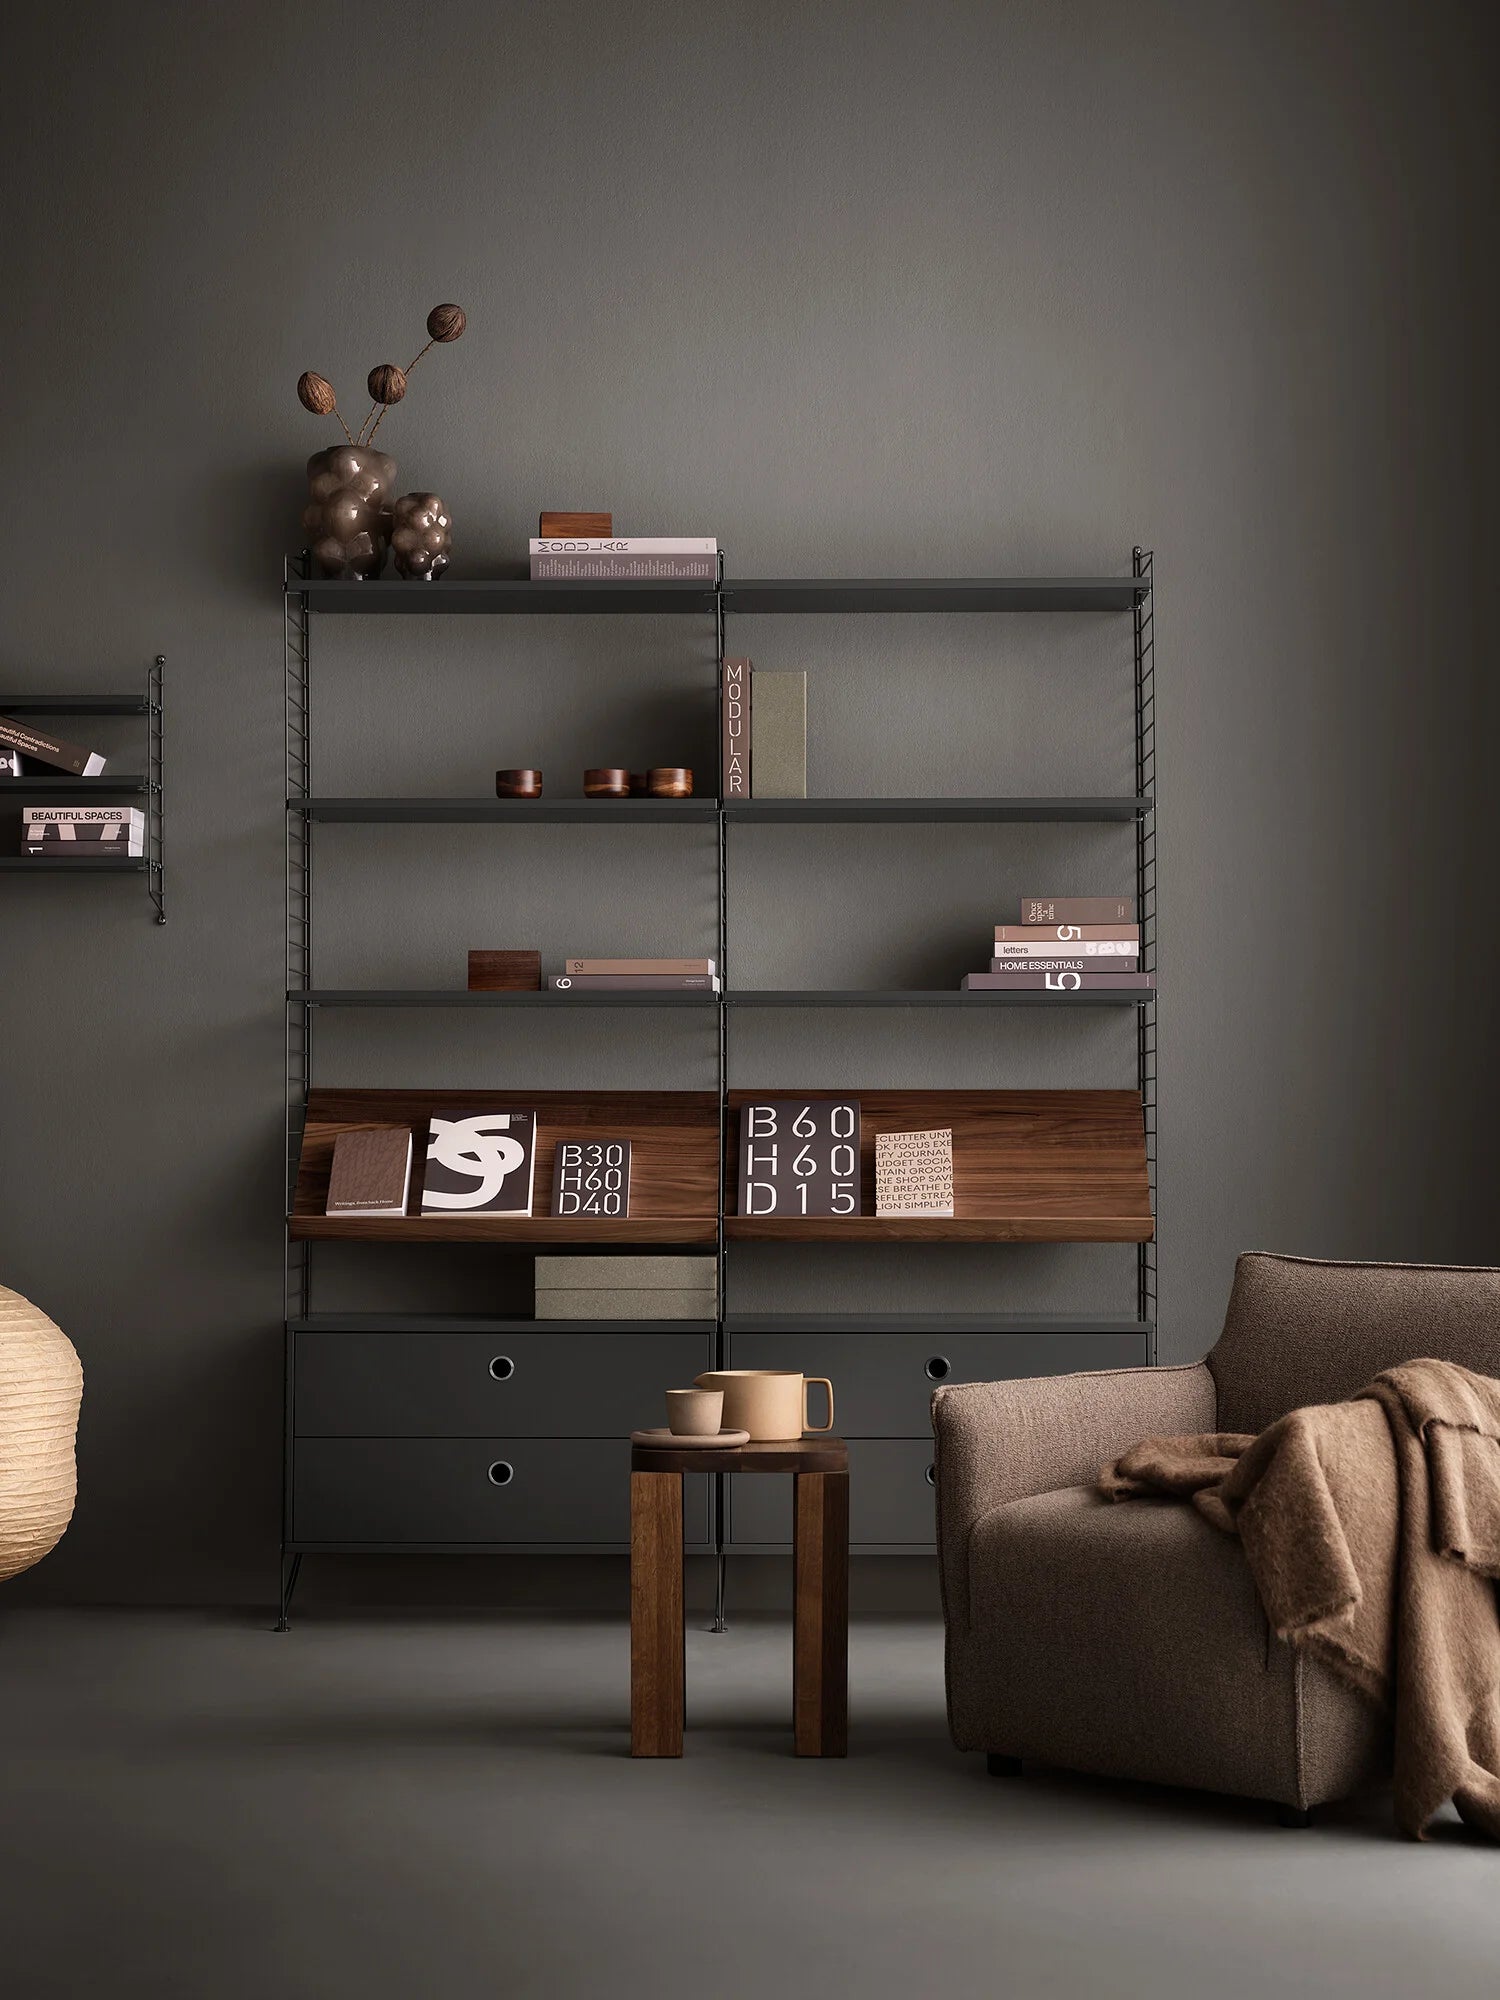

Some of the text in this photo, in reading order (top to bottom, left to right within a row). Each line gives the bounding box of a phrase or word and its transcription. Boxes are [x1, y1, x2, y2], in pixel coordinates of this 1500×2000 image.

[538, 542, 628, 552] MODULAR
[727, 665, 742, 792] MODULAR
[17, 740, 38, 752] Spaces
[32, 812, 122, 820] BEAUTIFUL SPACES
[1028, 902, 1036, 922] Once
[1037, 902, 1045, 922] upon
[1056, 925, 1081, 940] 5
[1003, 944, 1028, 954] letters
[574, 962, 584, 973] 12
[1000, 961, 1083, 970] HOME ESSENTIALS
[894, 1142, 930, 1150] FOCUS
[562, 1144, 624, 1167] B30
[898, 1149, 948, 1158] JOURNAL
[876, 1158, 951, 1168] UDGET SOCIA
[910, 1166, 951, 1174] GROOM
[560, 1168, 622, 1191] H60
[896, 1176, 926, 1184] SHOP
[894, 1184, 940, 1192] BREATHE
[920, 1192, 954, 1200] STREA
[559, 1192, 621, 1214] D40
[904, 1200, 952, 1209] SIMPLIFY
